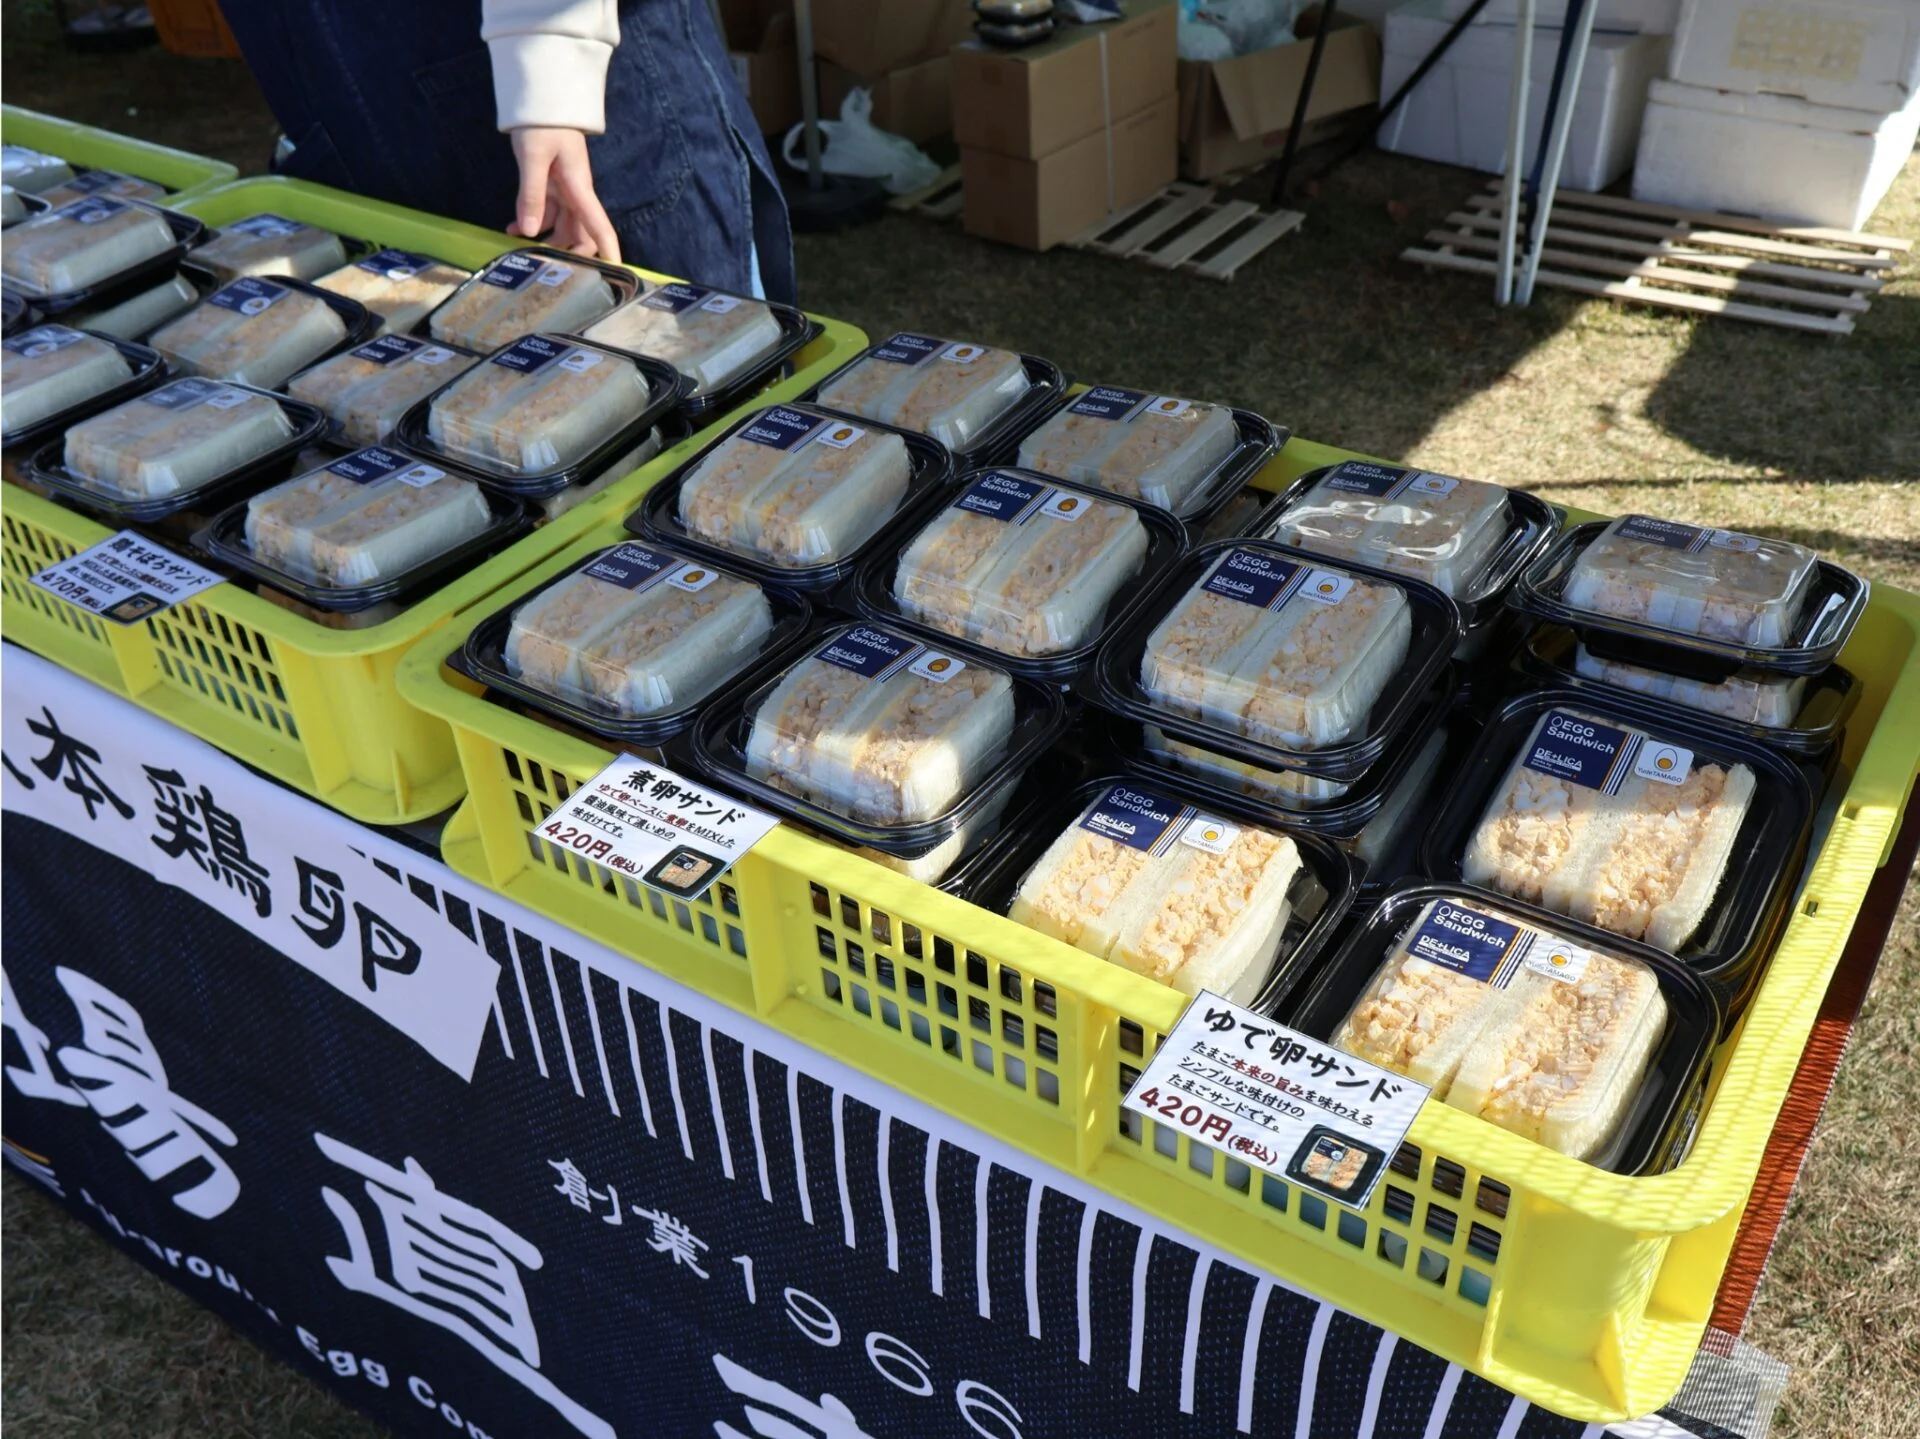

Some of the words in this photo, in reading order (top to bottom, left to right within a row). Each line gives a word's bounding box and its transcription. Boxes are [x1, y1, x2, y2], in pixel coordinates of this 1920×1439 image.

[980, 481, 1032, 500] Sandwich
[614, 551, 660, 572] Sandwich
[1228, 560, 1286, 581] Sandwich
[1242, 556, 1271, 569] EGG
[848, 634, 899, 656] Sandwich
[863, 630, 890, 644] EGG
[1547, 726, 1615, 754] Sandwich
[1562, 721, 1595, 737] EGG
[1537, 747, 1583, 767] DE+LICA
[622, 769, 746, 826] 煮卵サンド
[1109, 795, 1170, 823] Sandwich
[1124, 791, 1154, 808] EGG
[571, 806, 625, 839] 味付けです。
[1094, 811, 1136, 832] DE+LICA
[2, 706, 422, 992] 本鶏卵
[1433, 915, 1506, 948] Sandwich
[1450, 912, 1485, 930] EGG
[1421, 935, 1470, 959] DE+LICA
[1203, 1007, 1402, 1103] ゆで卵サンド
[1180, 1056, 1305, 1117] シンプルな味付けの
[1192, 1040, 1374, 1127] たまご本来の旨みを味わえる
[1168, 1073, 1280, 1132] たまごサンドです。
[296, 1324, 390, 1388] Egg
